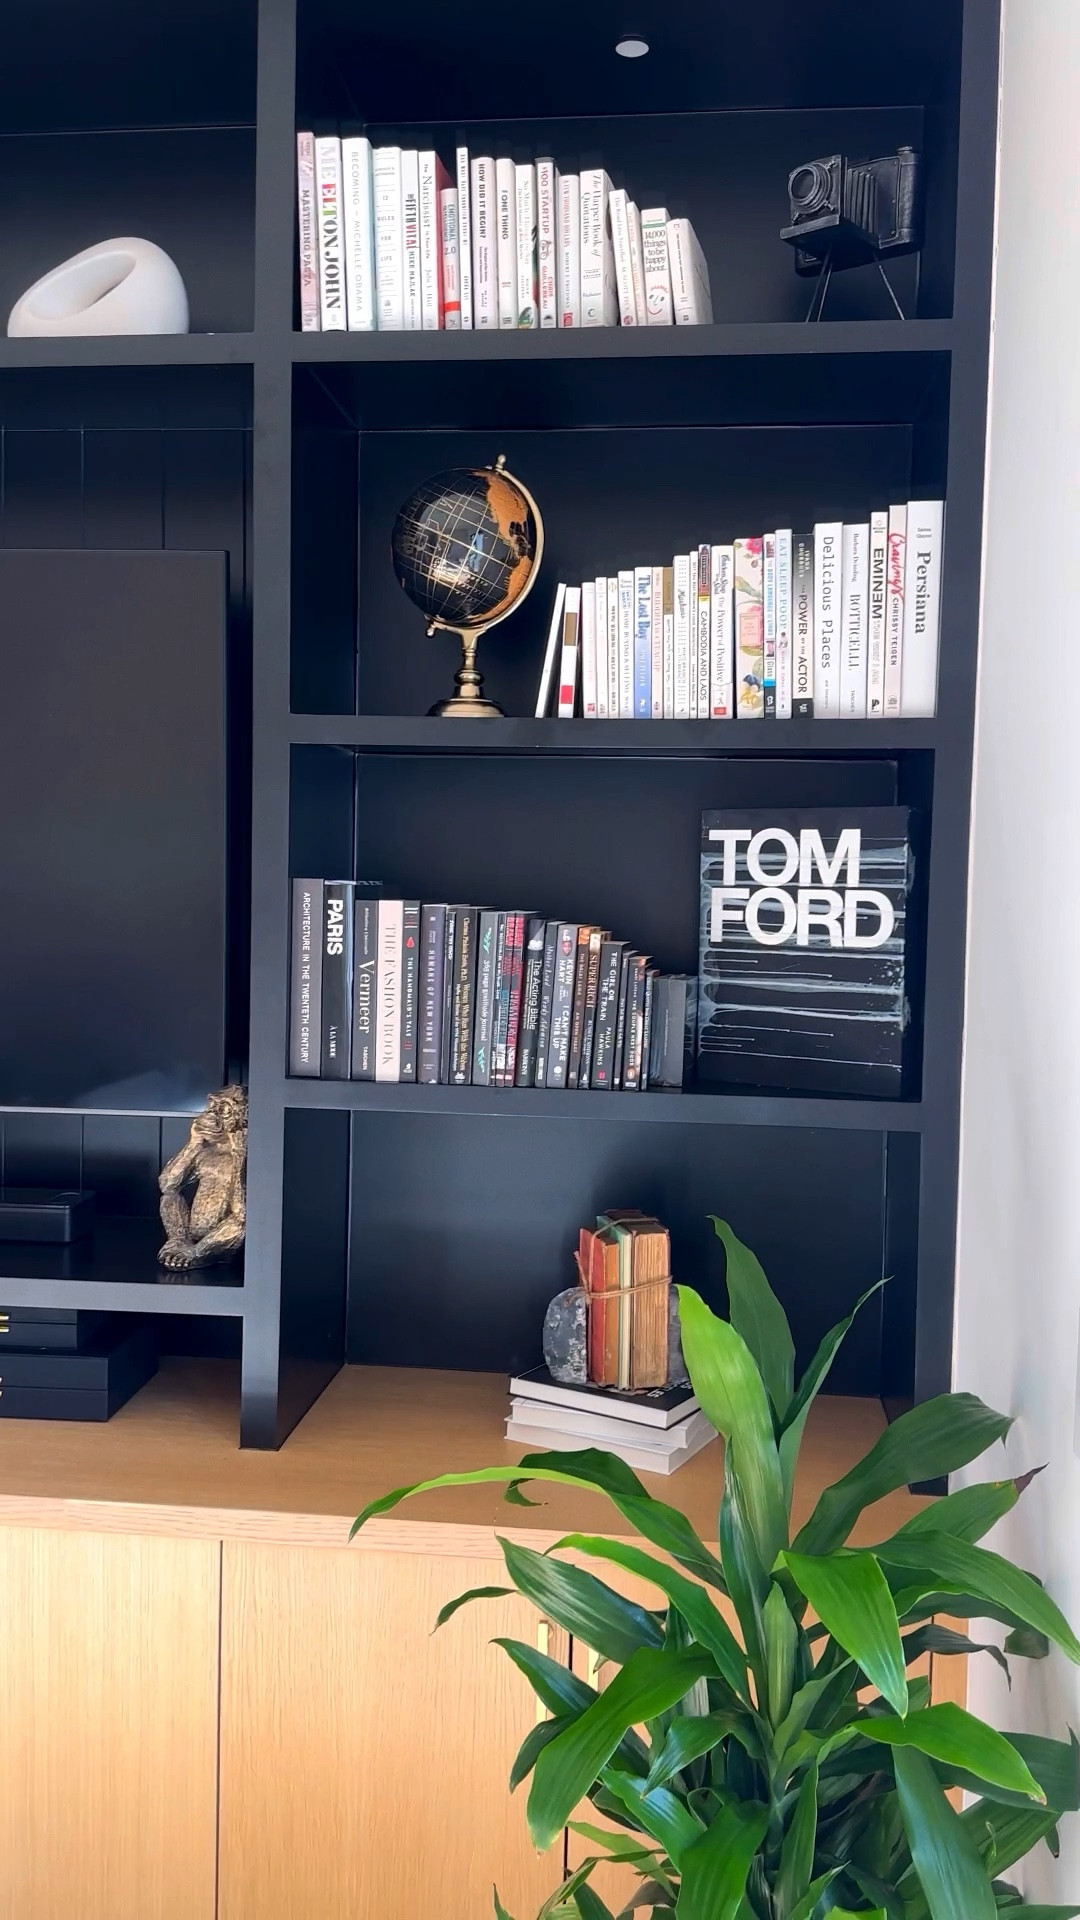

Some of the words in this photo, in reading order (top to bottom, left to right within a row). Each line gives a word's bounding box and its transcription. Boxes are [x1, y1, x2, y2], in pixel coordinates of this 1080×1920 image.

[320, 146, 336, 179] ME
[478, 163, 486, 182] HOW
[351, 152, 360, 205] BECOMING
[540, 167, 550, 187] $100
[593, 175, 602, 189] The
[422, 175, 433, 228] Narcissist
[478, 184, 486, 198] DID
[478, 200, 486, 208] IT
[321, 183, 339, 248] ELTON
[405, 199, 417, 223] FIFTH
[541, 190, 550, 234] STARTUP
[581, 192, 591, 244] Quotations
[591, 190, 602, 222] Harper
[302, 189, 312, 251] MASTERING
[447, 204, 457, 242] EMOTIONAL
[479, 210, 487, 239] BEGIN?
[501, 214, 509, 240] THING
[353, 220, 362, 269] MICHELLE
[406, 224, 417, 249] VITAL
[593, 224, 602, 248] Book
[644, 239, 666, 249] things
[444, 247, 457, 256] 2.0
[591, 249, 602, 258] of
[645, 256, 666, 265] happy
[655, 247, 664, 255] be
[303, 254, 312, 286] PASTA
[324, 251, 341, 309] JOHN
[355, 274, 363, 311] OBAMA
[779, 538, 787, 557] EAT
[721, 555, 731, 578] Chicken
[779, 562, 788, 595] SLEEP
[822, 536, 835, 611] Delicious
[887, 532, 907, 604] Cravings
[638, 575, 651, 595] The
[720, 578, 729, 594] Soup
[872, 548, 884, 619] EMINEM
[914, 550, 932, 634] Persiana
[638, 597, 651, 618] Lost
[780, 599, 788, 629] POOP
[798, 594, 807, 635] POWER
[891, 597, 899, 633] CHRISSY
[635, 620, 651, 640] Boy
[716, 609, 726, 639] Power
[848, 594, 861, 671] BOTTICELLI
[821, 620, 833, 669] Places
[890, 636, 898, 666] TEIGEN
[716, 648, 726, 683] Positive
[798, 656, 808, 693] ACTOR
[708, 827, 862, 887] TOM
[302, 892, 310, 950] ARCHITECTURE
[326, 899, 343, 955] PARIS
[709, 887, 895, 949] FORD
[384, 924, 396, 955] THE
[302, 953, 310, 962] IN
[427, 950, 436, 982] HUMANS
[532, 960, 541, 975] The
[587, 954, 598, 984] SUPER
[610, 951, 618, 967] THE
[302, 964, 310, 980] THE
[481, 973, 489, 988] page
[558, 959, 566, 983] HART
[565, 959, 574, 985] KEVIN
[608, 969, 617, 988] GIRL
[358, 960, 375, 1034] Vermeer
[383, 960, 397, 1018] FASHION
[405, 973, 413, 1018] HANDMAID'S
[426, 987, 435, 996] OF
[462, 983, 471, 1003] Women
[528, 977, 540, 1006] Acting
[586, 985, 596, 1009] RICH
[601, 978, 609, 994] THE
[607, 990, 615, 1001] ON
[301, 983, 310, 1024] TWENTETH
[426, 1000, 435, 1017] NEW
[461, 1004, 470, 1017] Who
[480, 988, 490, 1017] gratitude
[599, 997, 608, 1021] TRAIN
[461, 1017, 469, 1029] Run
[480, 1017, 489, 1041] journal
[529, 1008, 538, 1030] Bible
[554, 1017, 562, 1036] THIS
[561, 1010, 569, 1036] CAN'T
[575, 1012, 581, 1020] AN
[329, 1032, 337, 1040] LA
[382, 1024, 396, 1065] BOOK
[425, 1021, 434, 1042] YORK
[460, 1029, 469, 1042] With
[552, 1037, 561, 1049] UP
[604, 1027, 612, 1049] PAULA
[300, 1027, 309, 1063] CENTURY
[460, 1042, 468, 1051] the
[559, 1038, 568, 1061] MAKE
[596, 1033, 605, 1066] HAWKINS
